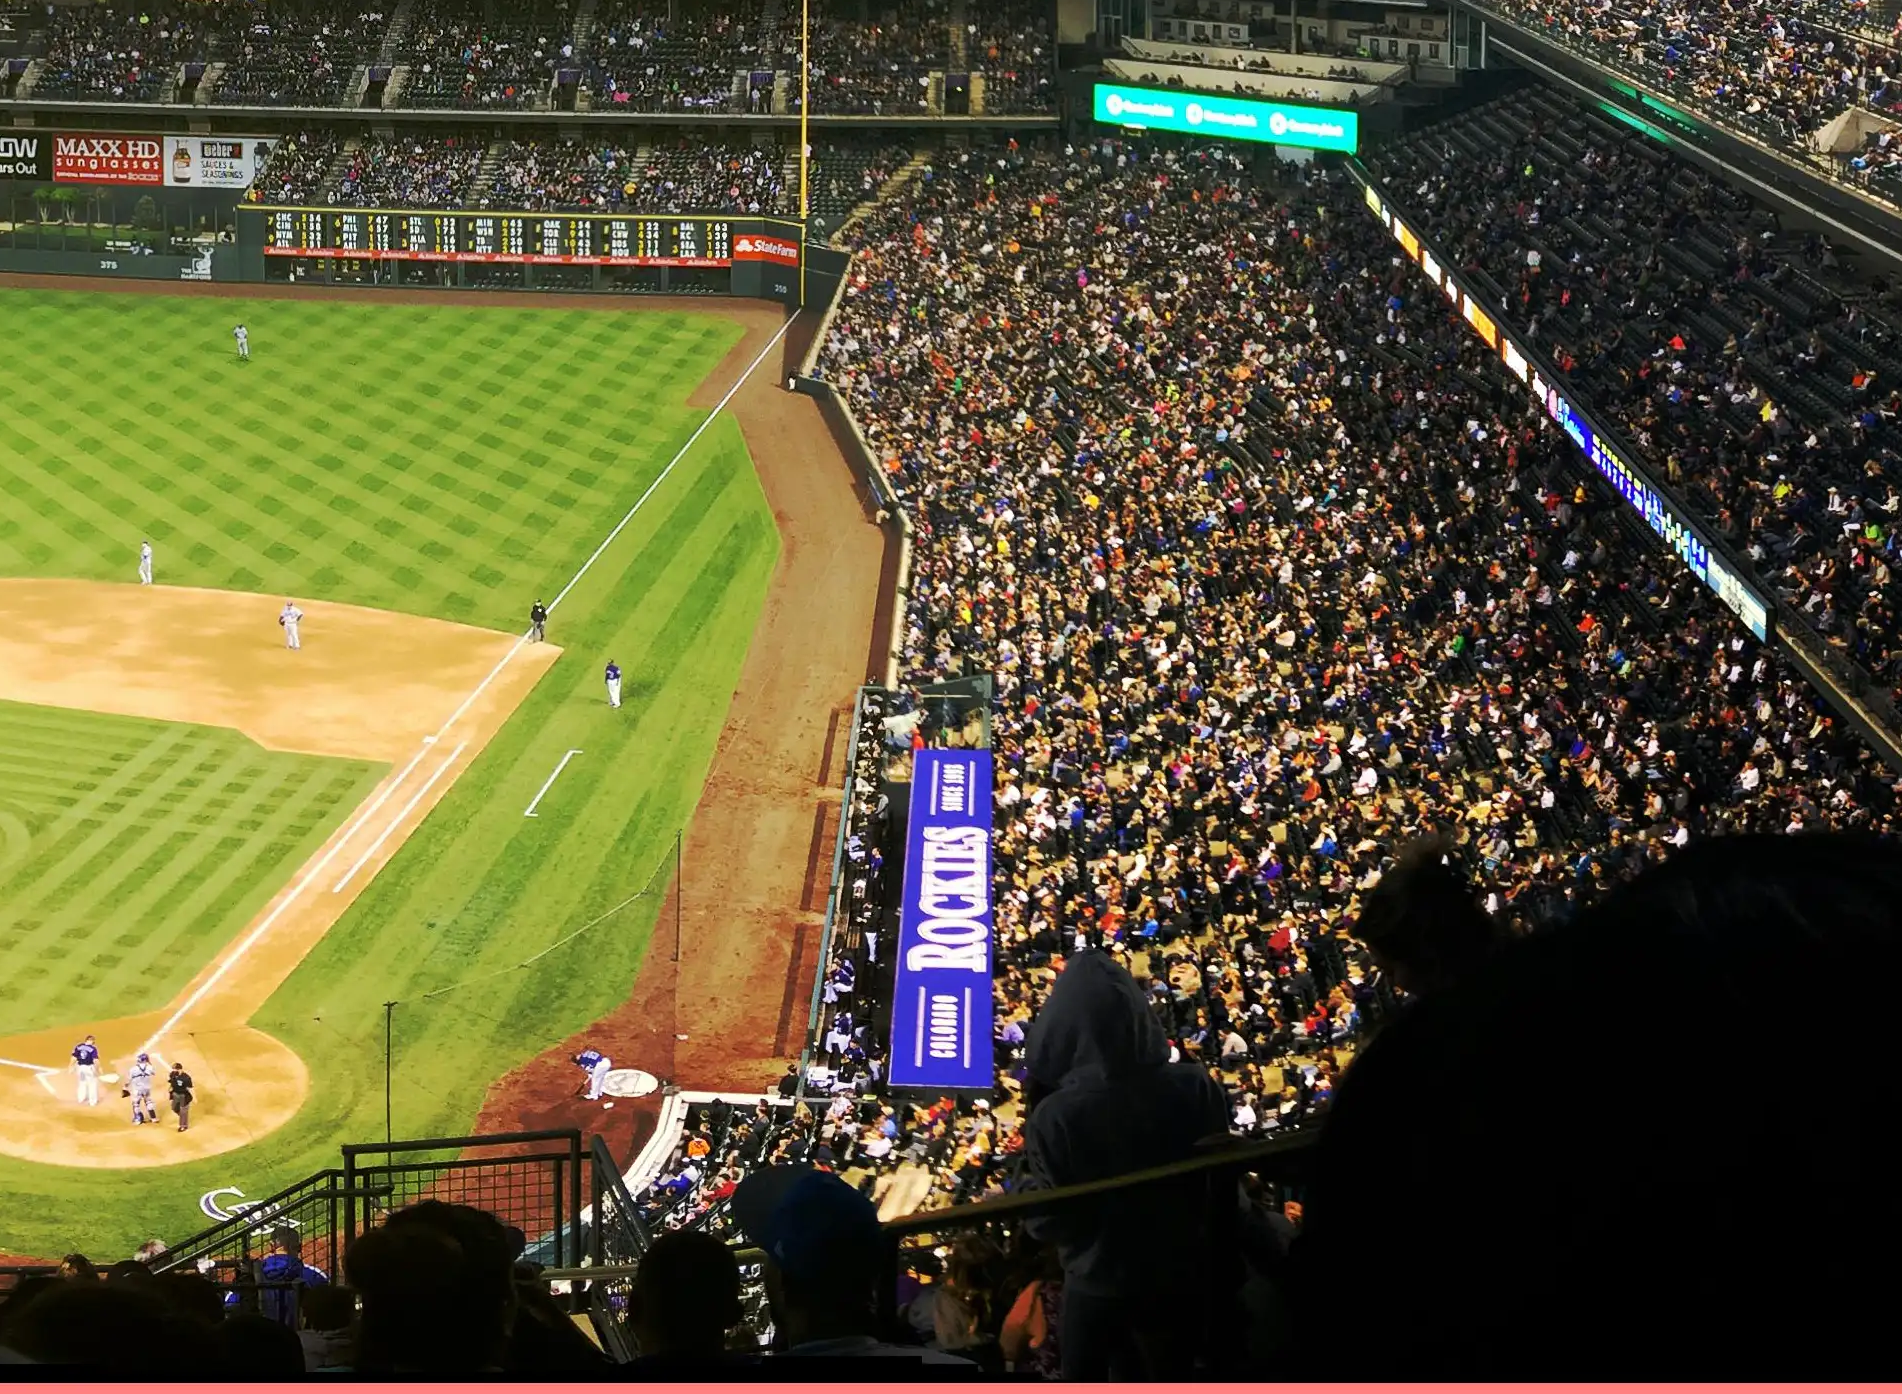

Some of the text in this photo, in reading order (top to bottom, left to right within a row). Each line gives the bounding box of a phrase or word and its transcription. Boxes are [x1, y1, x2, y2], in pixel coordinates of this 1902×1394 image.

[56, 137, 160, 159] MAXX HD
[203, 141, 234, 157] weber
[56, 157, 160, 170] sunglasses
[201, 160, 227, 169] SAUCES
[16, 162, 38, 175] Out
[276, 221, 291, 230] CIN
[409, 216, 422, 226] STL
[476, 218, 493, 227] MIN
[543, 220, 561, 229] OAK
[611, 221, 626, 230] TEX
[409, 225, 420, 235] SD
[680, 222, 695, 231] BAL
[276, 230, 293, 239] NYM
[343, 232, 357, 242] PIT
[543, 228, 559, 237] TOR
[680, 231, 692, 240] KC
[409, 235, 426, 244] MIA
[543, 238, 558, 247] CLE
[611, 239, 628, 248] BOS
[680, 240, 696, 249] SEA
[100, 260, 118, 270] 375
[941, 785, 965, 812] SINCE
[906, 826, 989, 973] ROCKIES
[929, 994, 959, 1058] COLORADO
